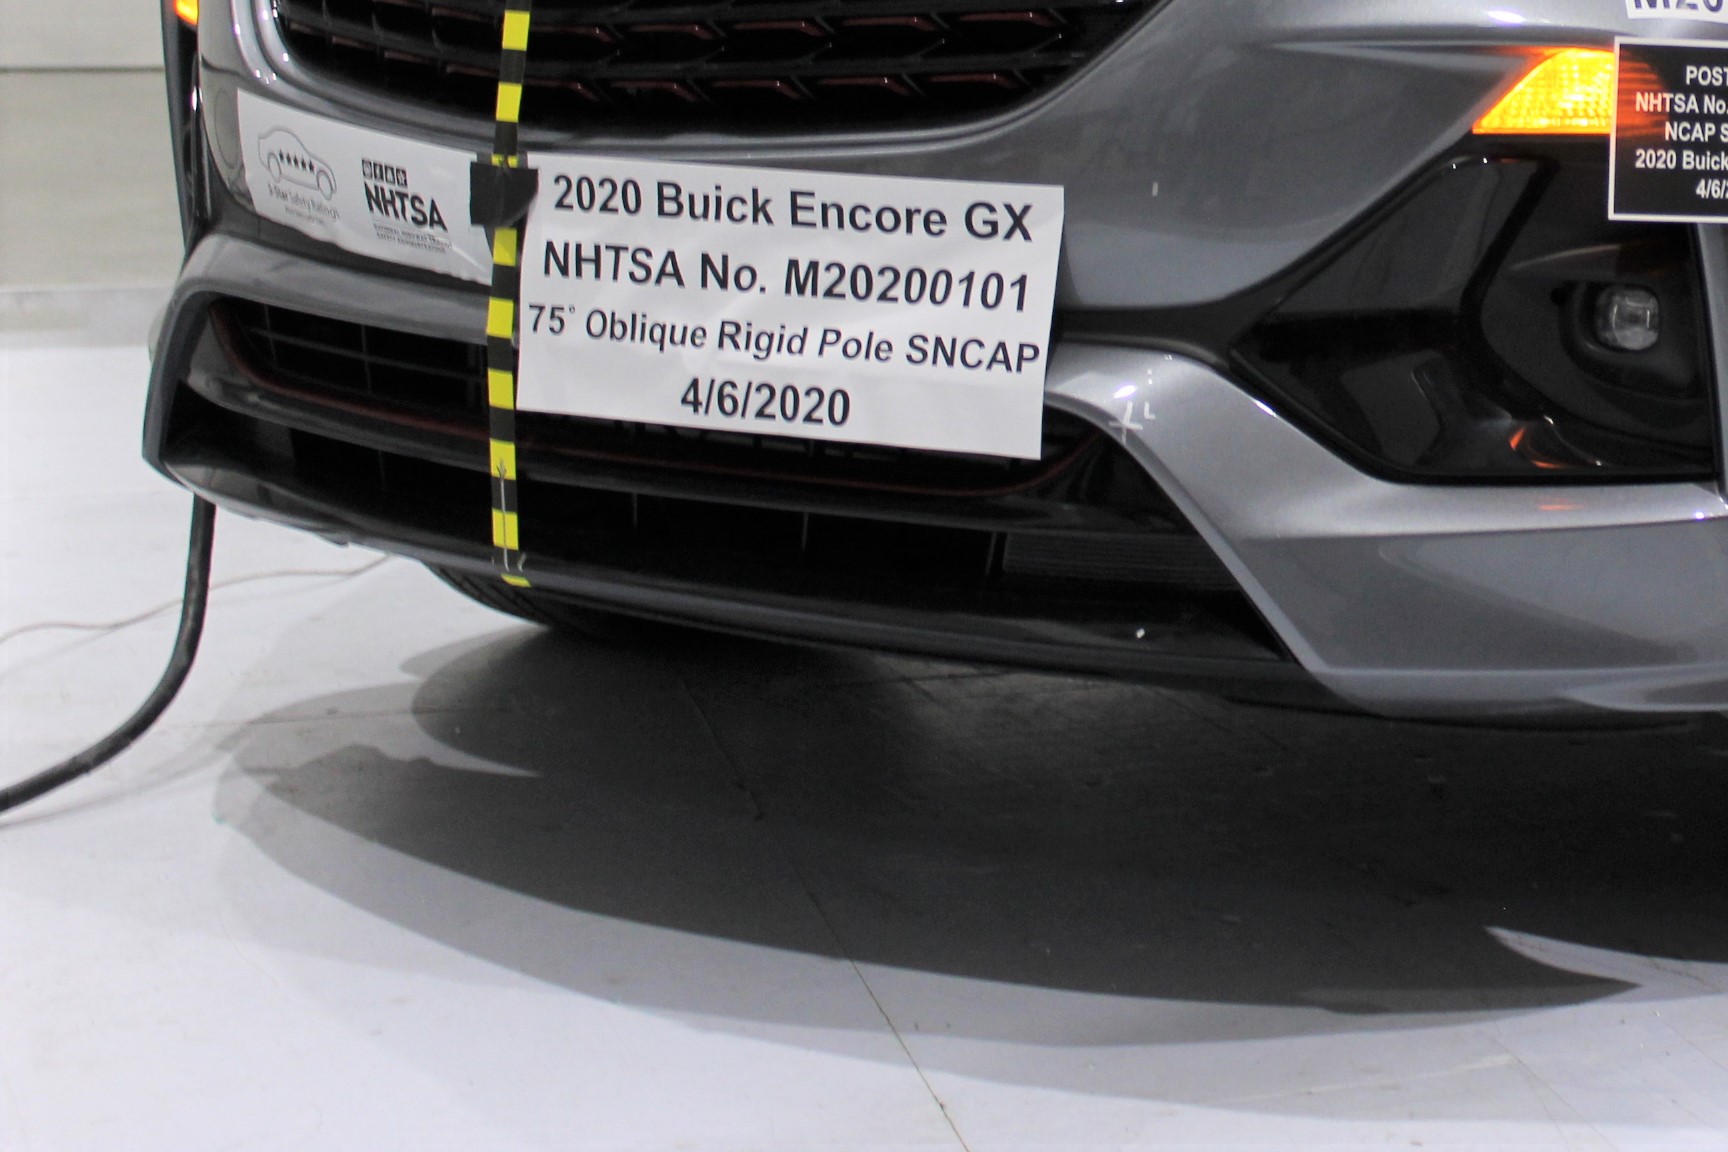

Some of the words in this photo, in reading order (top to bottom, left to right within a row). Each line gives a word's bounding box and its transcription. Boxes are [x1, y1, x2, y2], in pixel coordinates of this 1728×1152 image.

[1635, 91, 1699, 114] NHTSA
[1664, 121, 1716, 142] NCAP
[1635, 149, 1677, 169] 2020
[363, 181, 449, 234] NHTSA
[553, 174, 643, 215] 2020
[656, 180, 775, 227] Buick
[789, 190, 948, 237] Encore
[963, 201, 1034, 242] GX
[543, 240, 686, 289] NHTSA
[699, 253, 767, 294] No.
[784, 258, 1030, 313] M20200101
[585, 308, 708, 350] Oblique
[717, 319, 810, 361] Rigid
[818, 327, 894, 363] Pole
[905, 333, 1042, 375] SNCAP
[680, 377, 852, 427] 4/6/2020
